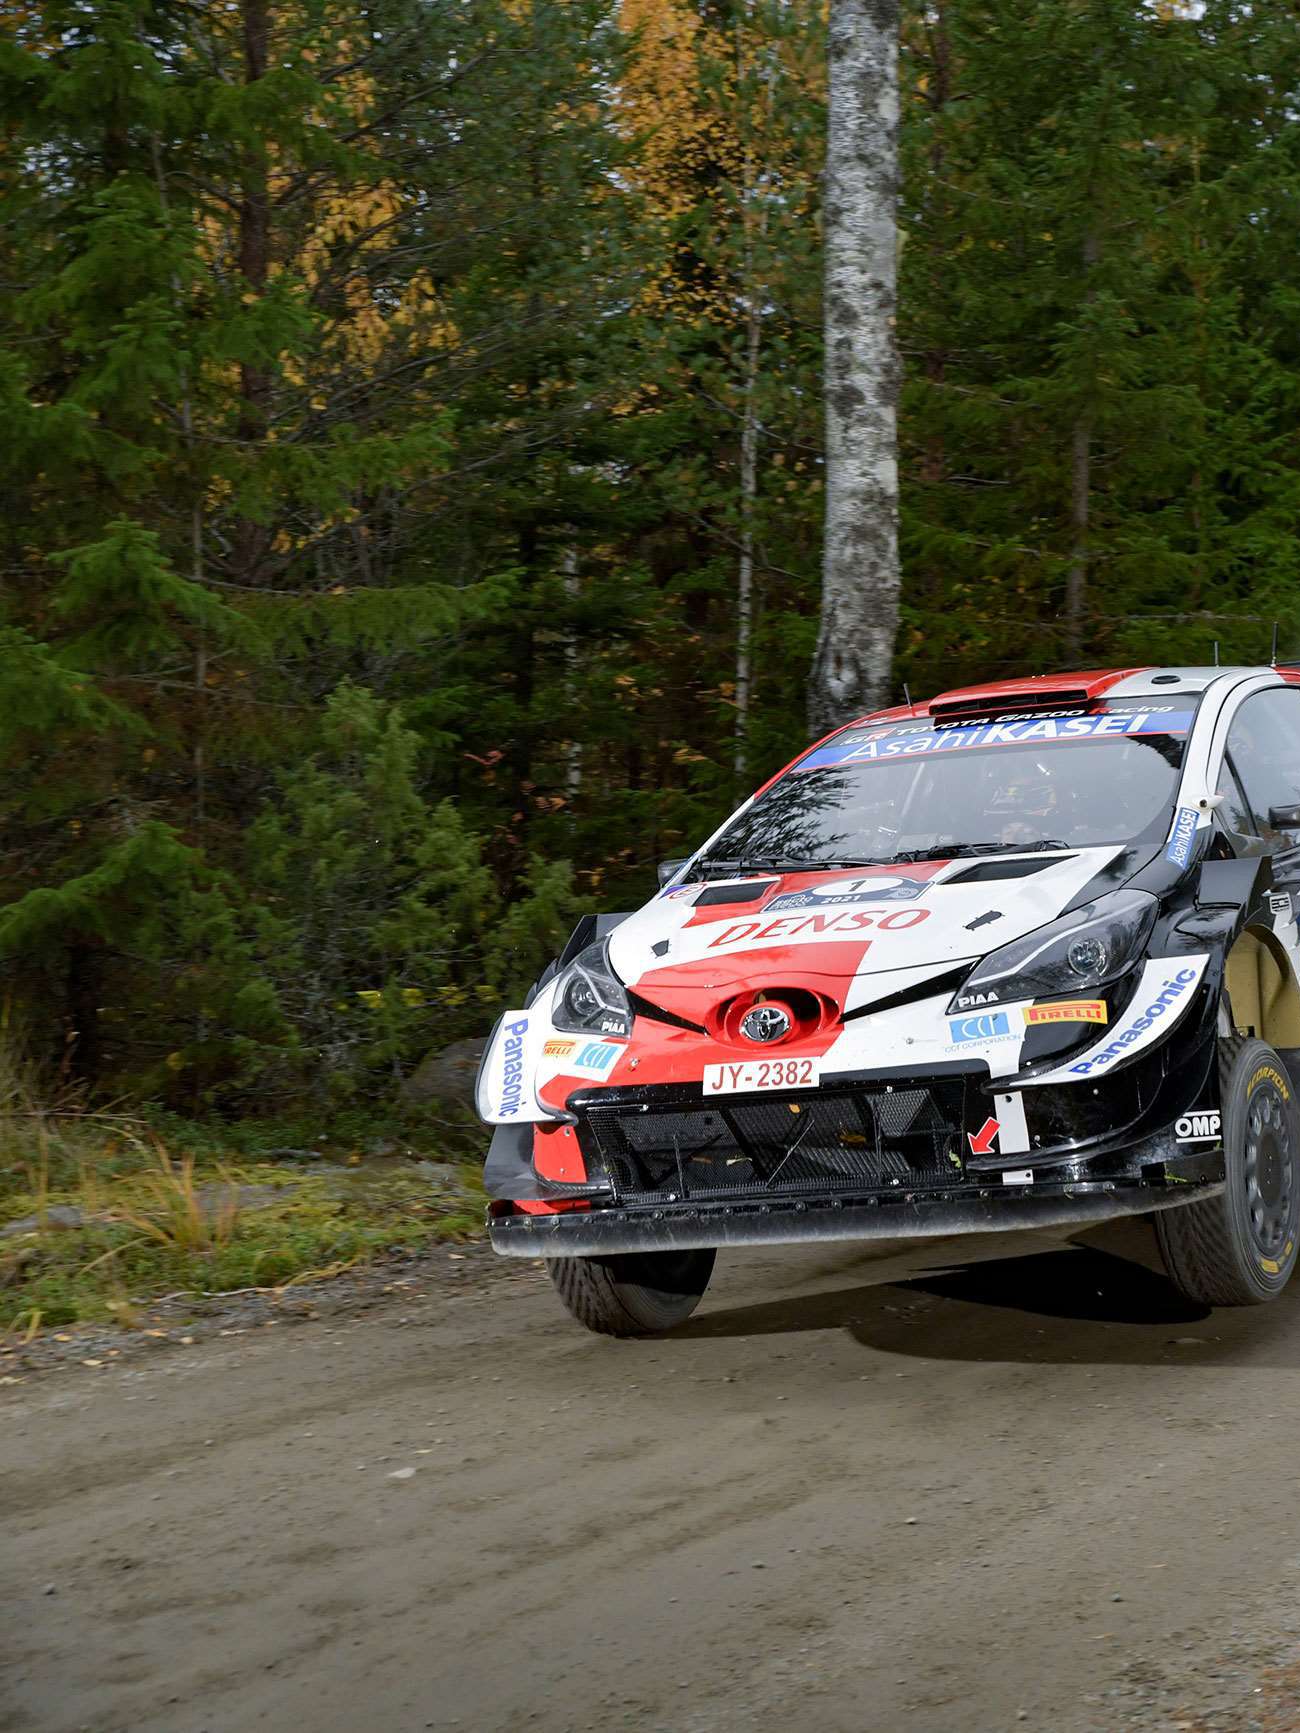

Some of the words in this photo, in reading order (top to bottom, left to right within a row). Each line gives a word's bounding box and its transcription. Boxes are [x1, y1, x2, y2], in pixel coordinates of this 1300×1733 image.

[897, 717, 990, 735] TOYOTA
[995, 709, 1086, 723] GAZOO
[1088, 704, 1175, 715] Racing
[849, 879, 867, 892] 1
[706, 908, 931, 949] DENSO
[958, 991, 999, 1008] PIAA
[1029, 1003, 1101, 1021] PIRELLI
[601, 1021, 625, 1034] PIAA
[1067, 968, 1197, 1074] Panasonic
[498, 1018, 528, 1117] Panasonic
[711, 1060, 814, 1090] JY-2382
[1247, 1066, 1290, 1102] SCORPION
[1175, 1115, 1221, 1137] OMP
